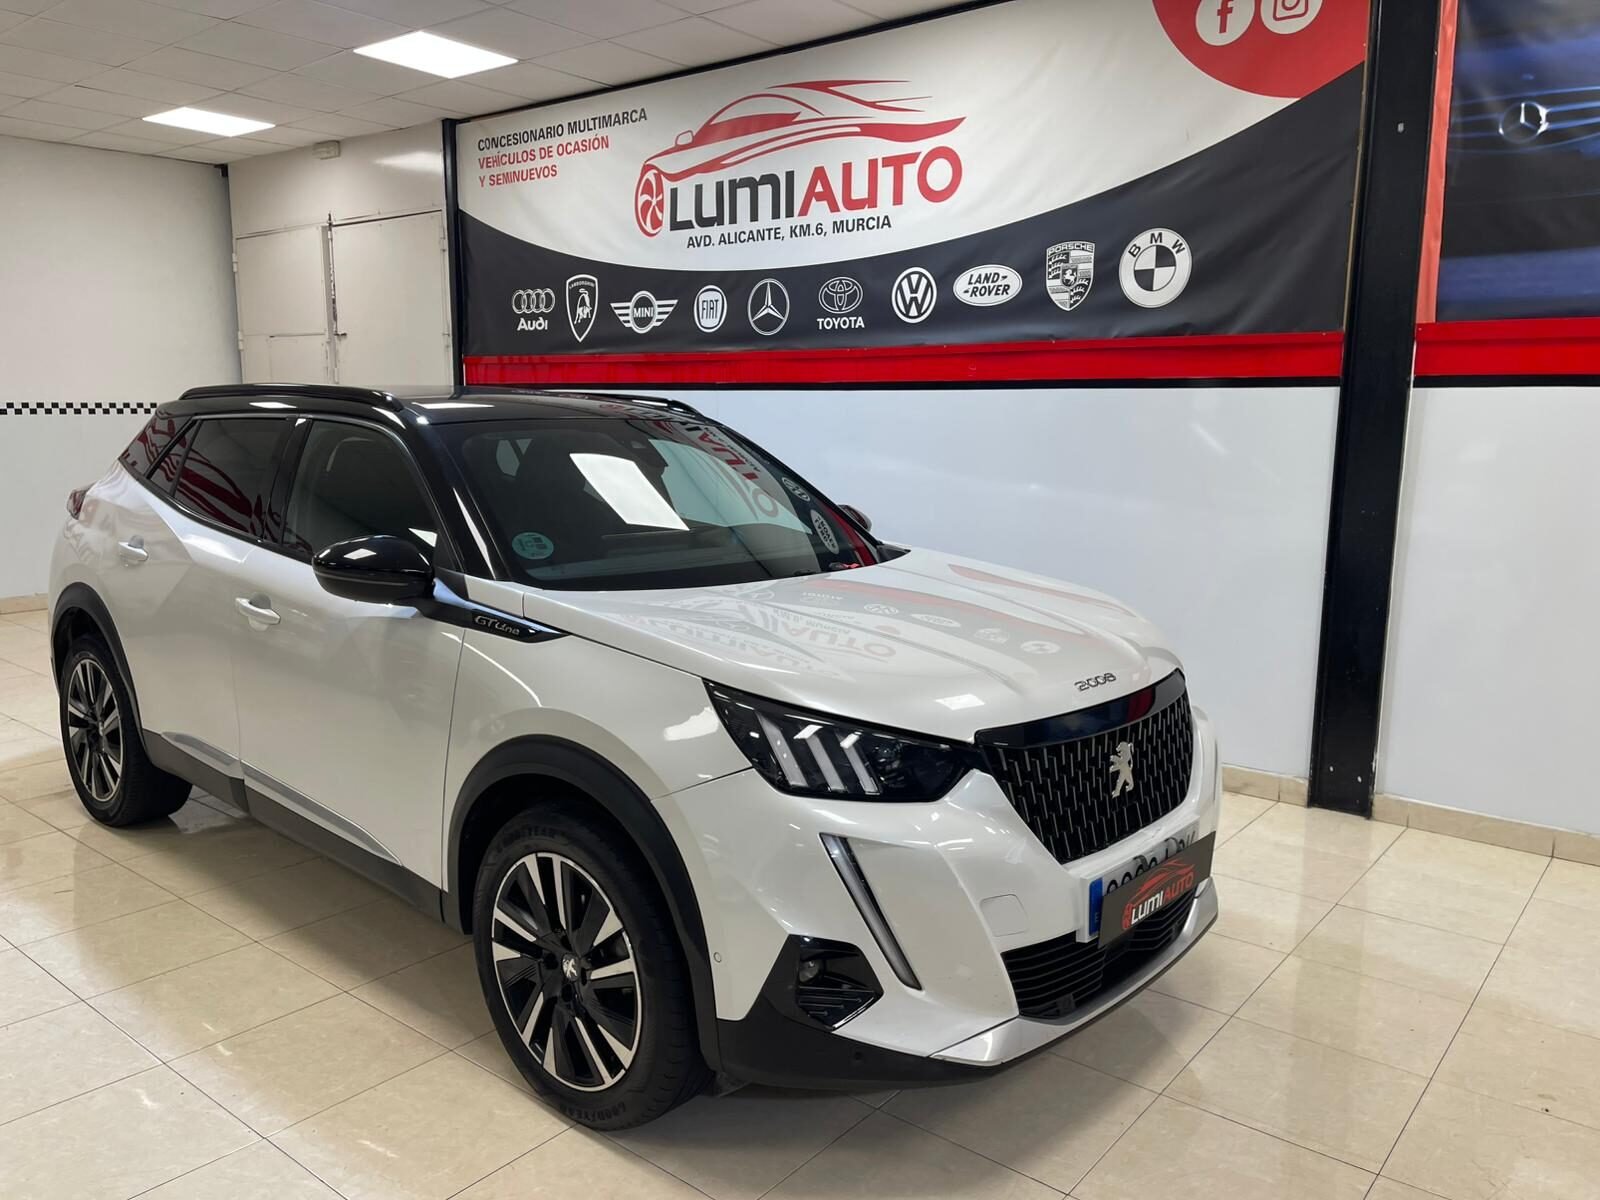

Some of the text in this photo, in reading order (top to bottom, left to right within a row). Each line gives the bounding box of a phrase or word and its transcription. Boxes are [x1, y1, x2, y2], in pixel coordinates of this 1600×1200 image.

[478, 108, 648, 151] CONCESIONARIO MULTIMARCA
[478, 134, 609, 170] VEHÍCULOS DE OCASIÓN
[479, 164, 557, 188] Y SEMINUEVOS
[687, 215, 892, 249] AVD. ALICANTE, KM.6, MURCIA
[1047, 242, 1094, 257] PORSCHE
[1128, 232, 1185, 258] BMW
[968, 273, 1000, 285] LAND
[969, 283, 1011, 297] ROVER
[633, 307, 654, 318] MINI
[701, 298, 719, 319] FIAT
[517, 317, 548, 331] Audi
[817, 316, 865, 330] TOYOTA
[1074, 673, 1117, 692] 2008
